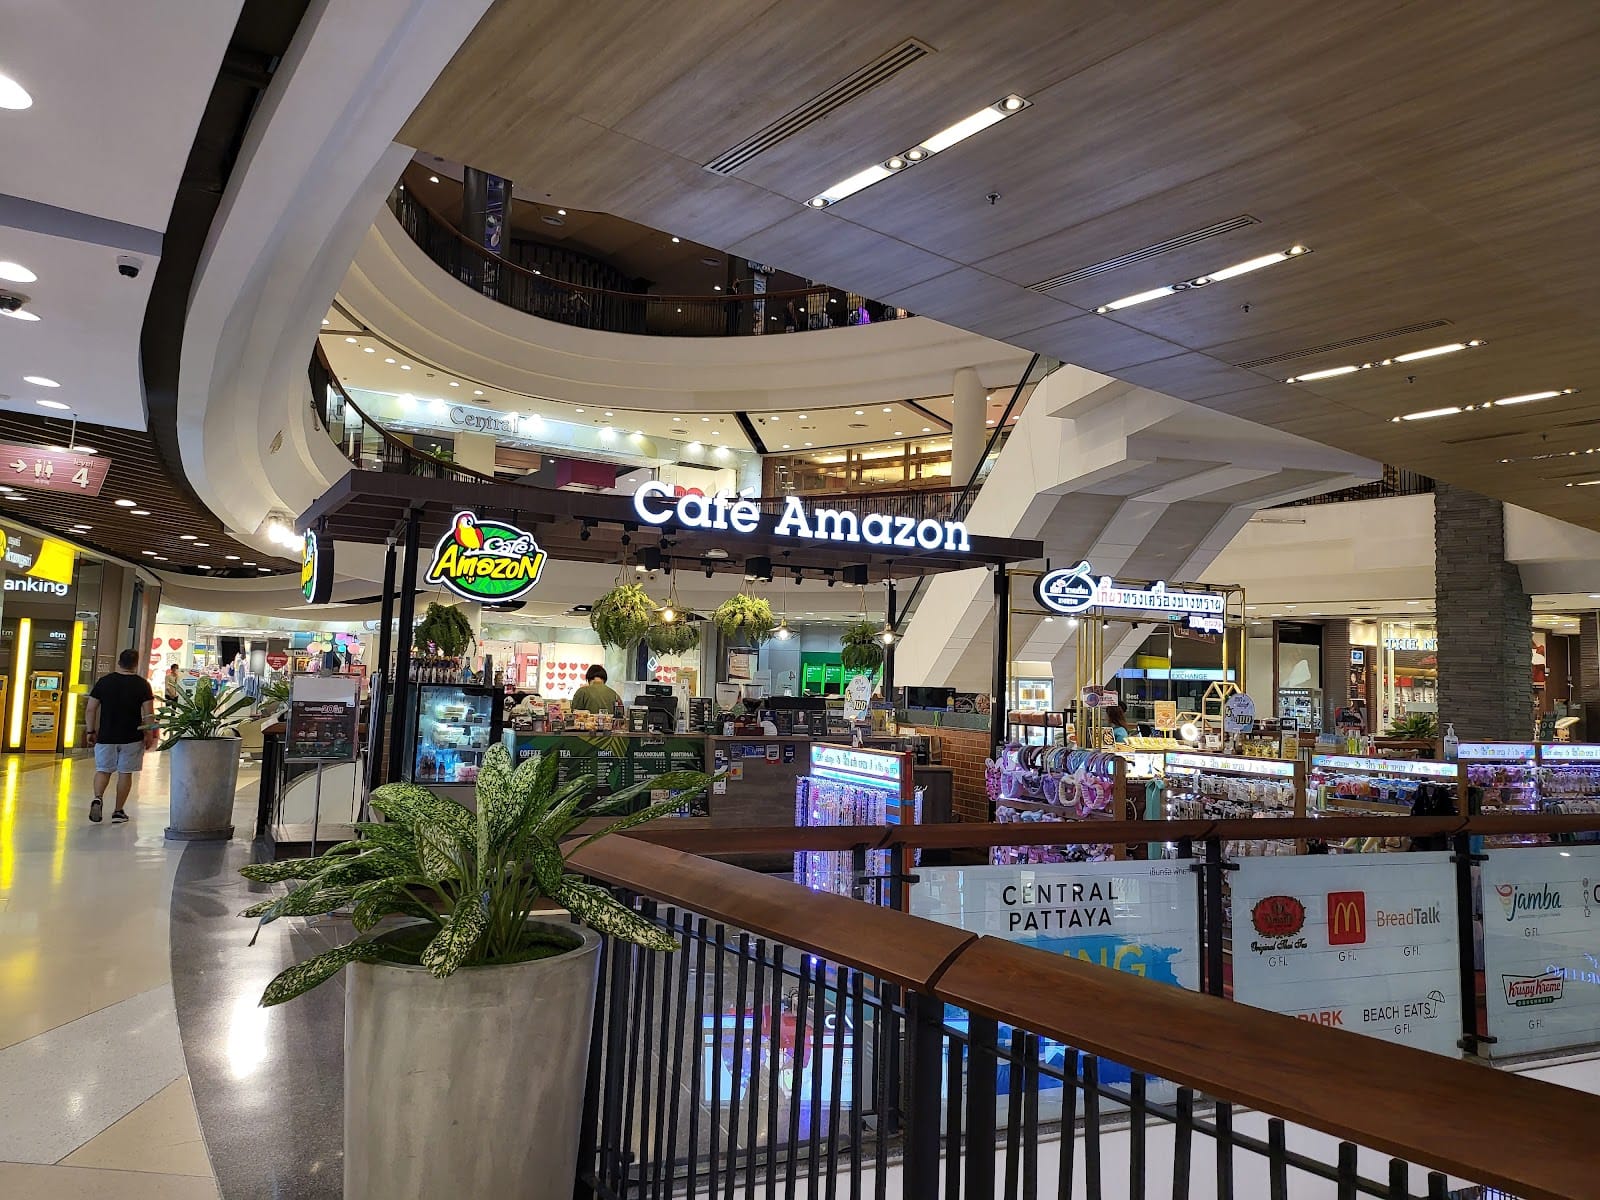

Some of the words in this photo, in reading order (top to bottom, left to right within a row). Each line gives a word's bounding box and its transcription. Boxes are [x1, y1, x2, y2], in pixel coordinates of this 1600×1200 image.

[449, 406, 520, 434] Central
[73, 458, 95, 468] level
[71, 467, 90, 489] 4
[633, 480, 760, 533] Café
[774, 496, 971, 551] Amazon
[3, 577, 69, 597] anking
[1385, 638, 1419, 651] THE
[1423, 638, 1438, 651] N
[1171, 672, 1208, 680] EXCHANGE
[1126, 692, 1140, 700] Best
[1002, 881, 1119, 906] CENTRAL
[1506, 883, 1562, 922] jamba
[1009, 907, 1112, 932] PATTAYA
[1376, 906, 1441, 928] BreadTalk
[1508, 980, 1536, 998] Krispy
[1363, 1006, 1400, 1022] BEACH
[1404, 1002, 1432, 1018] EATS
